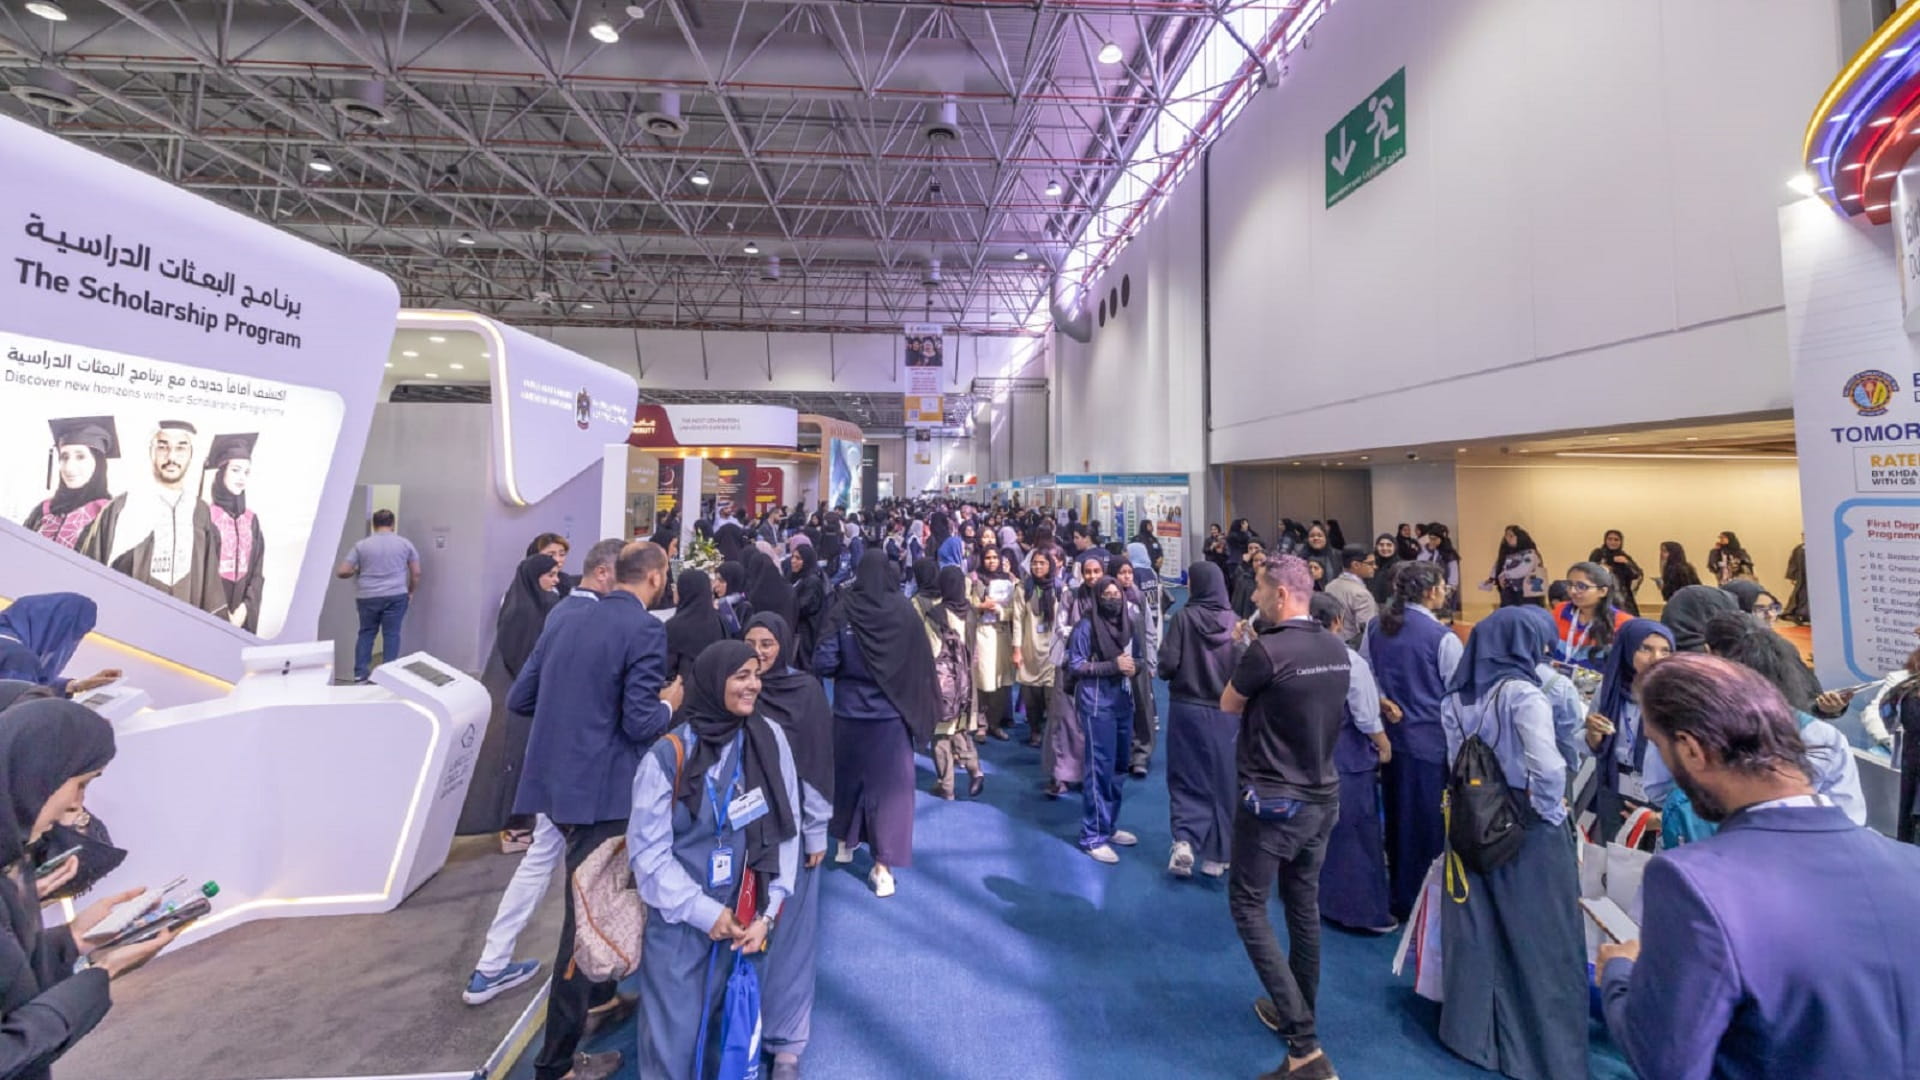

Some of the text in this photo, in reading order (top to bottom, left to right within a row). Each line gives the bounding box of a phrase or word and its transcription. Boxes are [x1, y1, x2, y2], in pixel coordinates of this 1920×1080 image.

[25, 212, 301, 320] برنامج البعثات الدراسية
[14, 257, 301, 349] The Scholarship Program
[7, 346, 72, 370] الدراسية
[77, 357, 125, 379] البعثات
[128, 367, 163, 384] برنامج
[5, 369, 62, 388] Discover
[64, 380, 91, 392] new
[93, 382, 141, 399] horizons
[143, 390, 165, 401] with
[167, 375, 186, 389] مع
[190, 375, 223, 392] جديدة
[1888, 469, 1918, 477] KHDA
[1867, 519, 1891, 528] First
